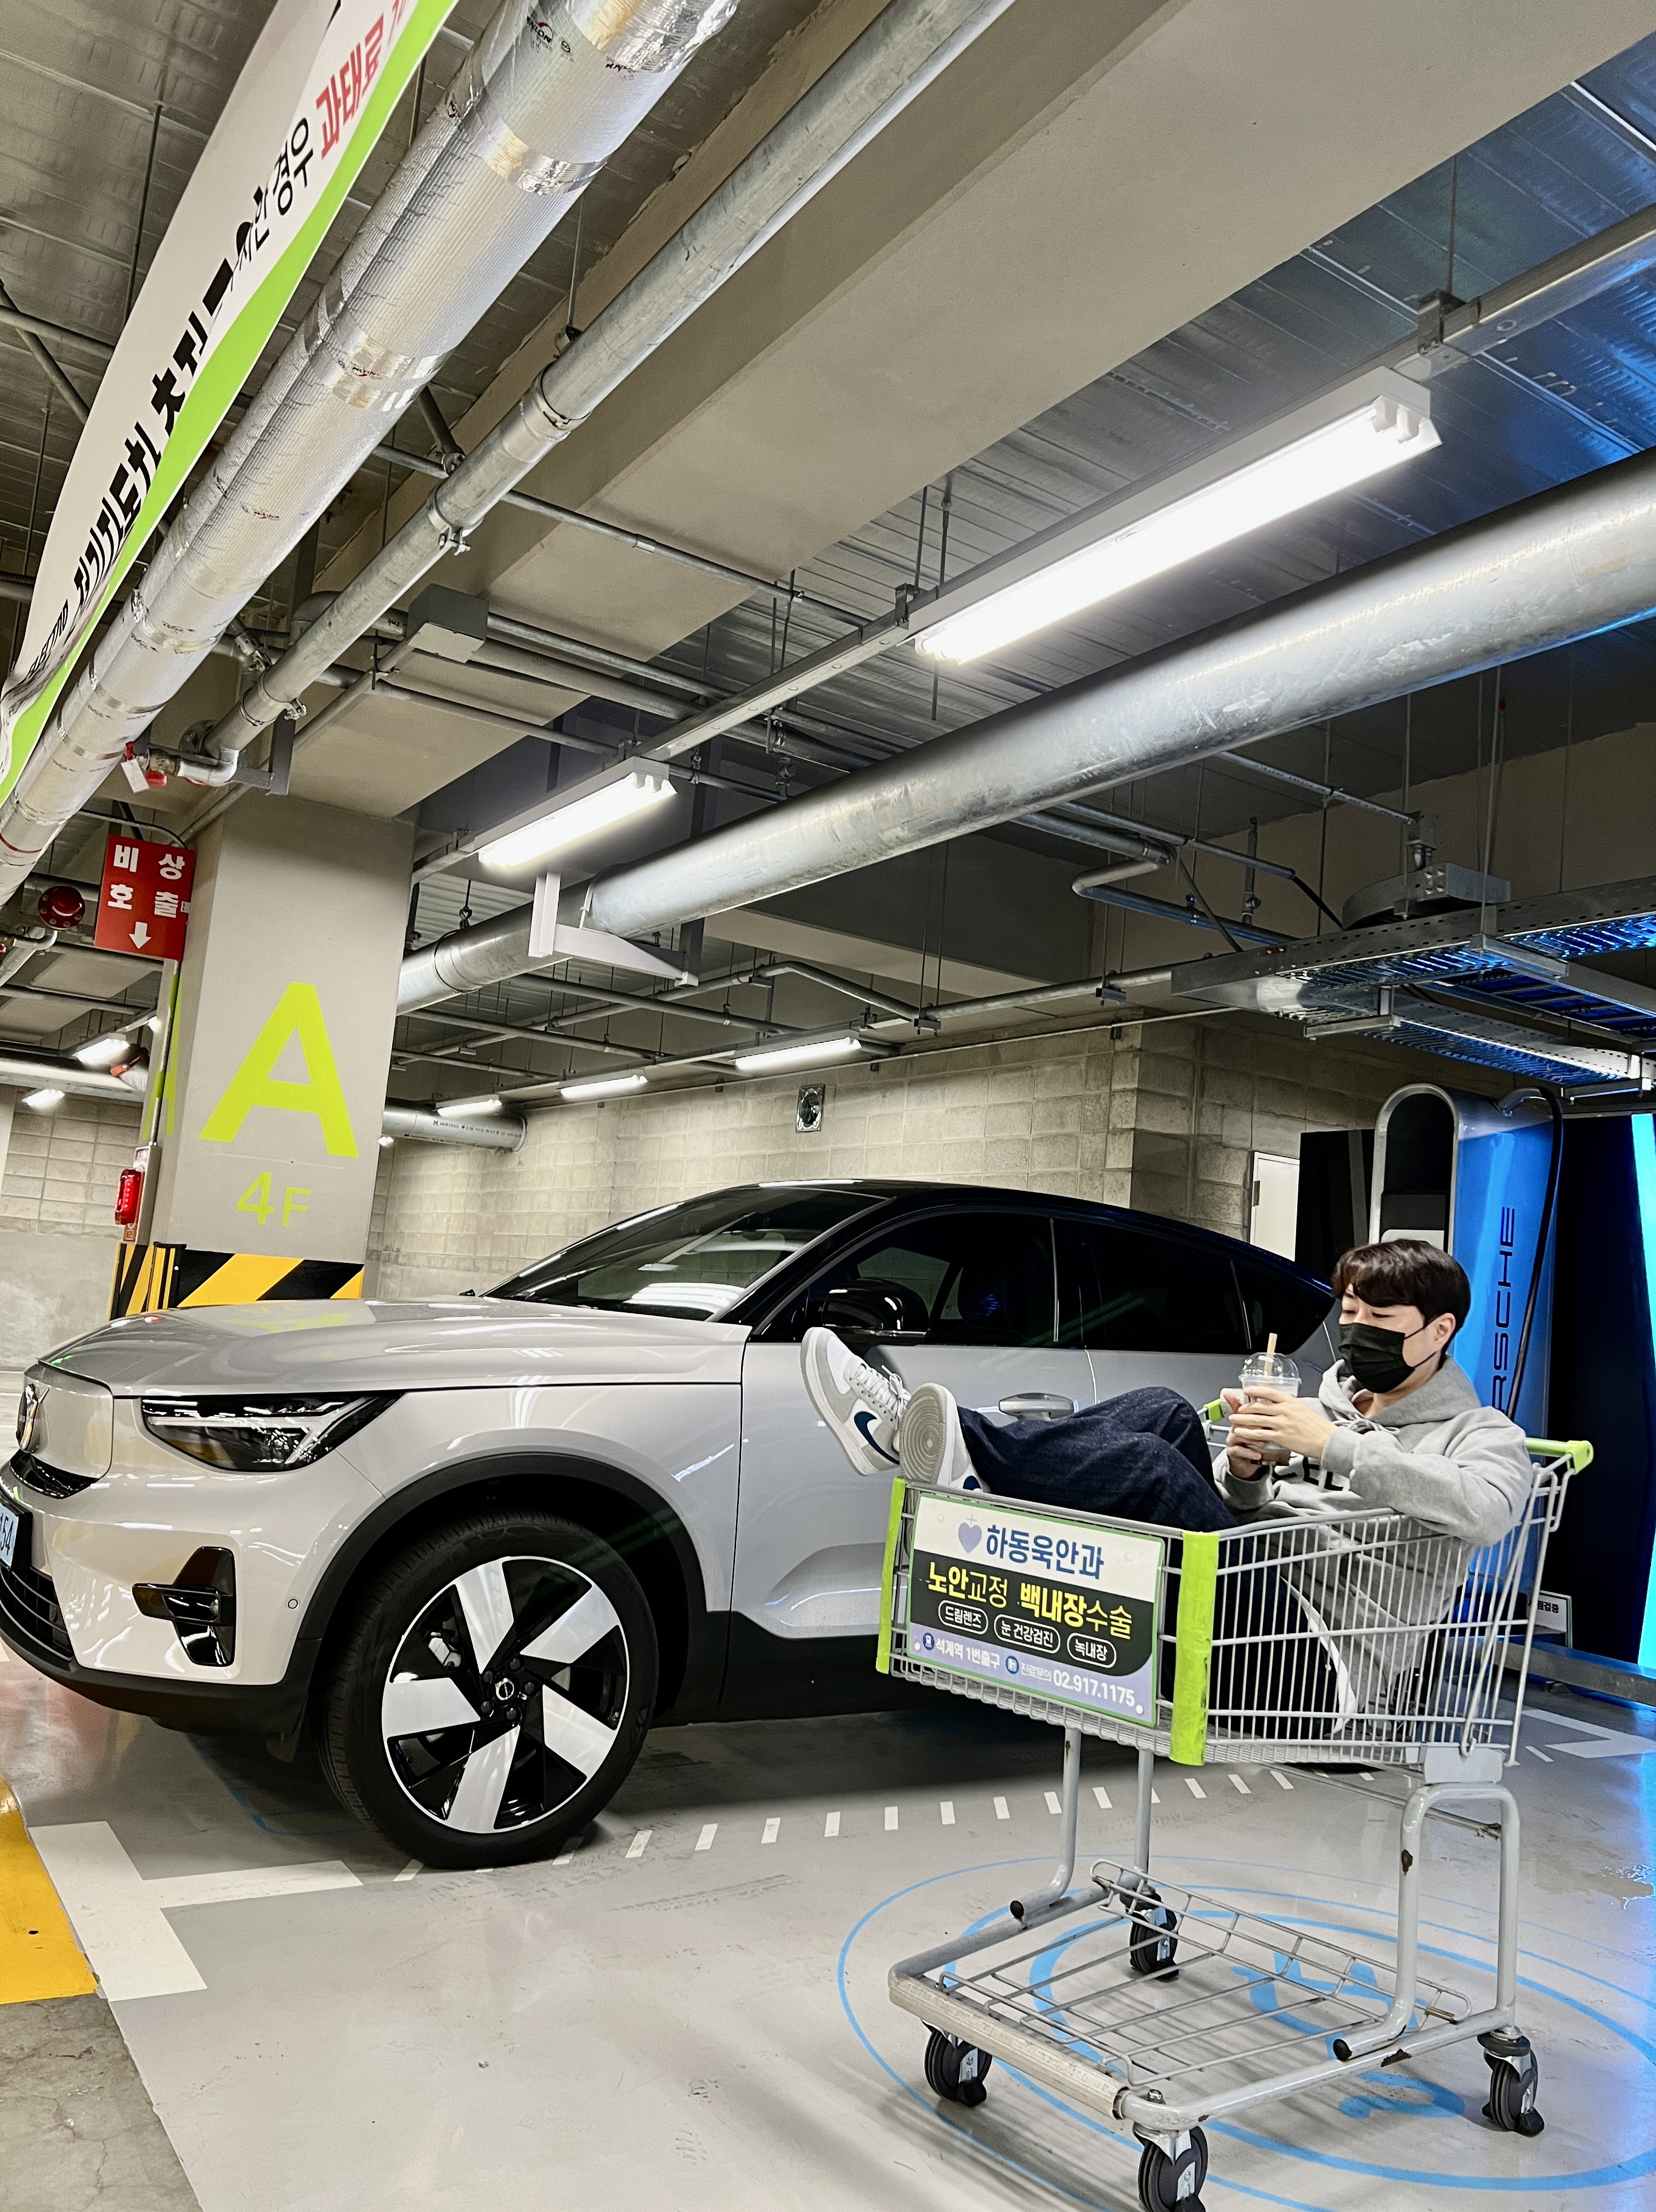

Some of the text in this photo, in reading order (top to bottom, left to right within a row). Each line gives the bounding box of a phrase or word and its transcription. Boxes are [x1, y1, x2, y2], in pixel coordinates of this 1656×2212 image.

[316, 13, 383, 160] 과태료
[198, 981, 359, 1159] A
[236, 1172, 312, 1227] 4F
[987, 1525, 1104, 1580] 하동욱안과
[928, 1561, 1132, 1640] 노안교정 백내장수술
[945, 1605, 982, 1629] 드림렌즈
[936, 1638, 1001, 1669] 석계역 1번출구
[1001, 1620, 1054, 1648] 눈 건강검진
[1074, 1638, 1107, 1662] 녹내장
[1053, 1669, 1135, 1707] 02.917.1175
